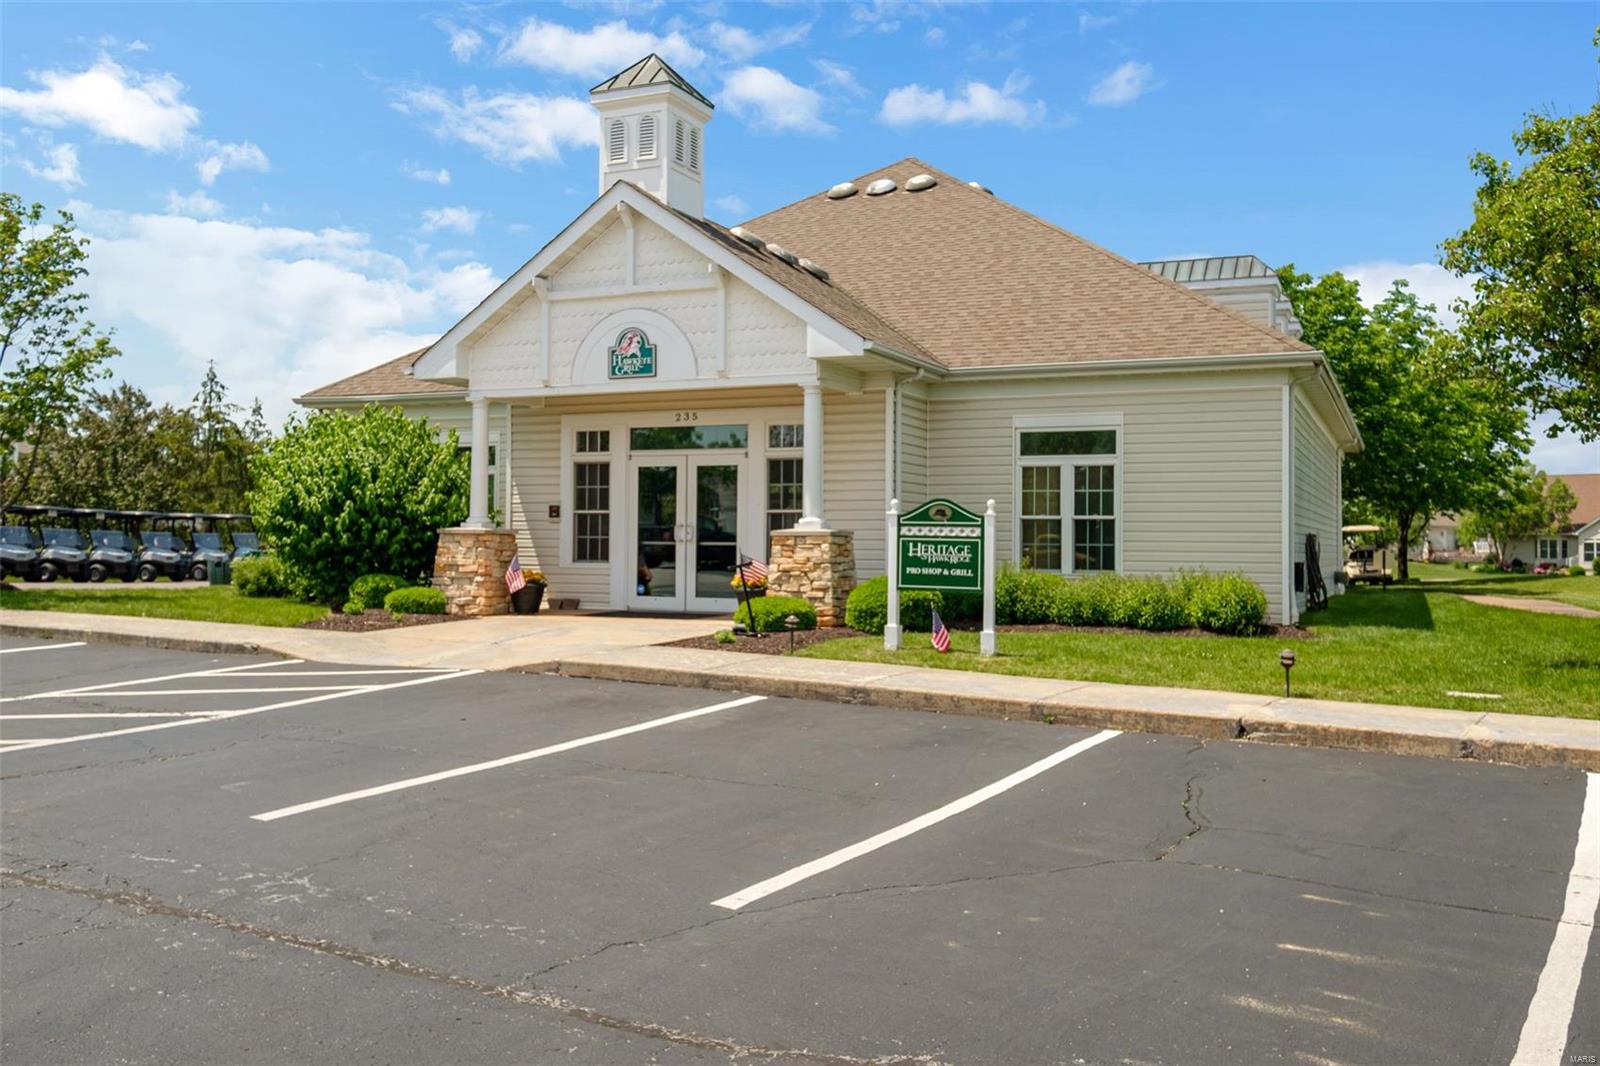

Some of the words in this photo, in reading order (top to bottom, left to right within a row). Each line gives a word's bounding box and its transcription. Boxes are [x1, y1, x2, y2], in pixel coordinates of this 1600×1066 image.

[675, 411, 698, 422] 235
[908, 542, 972, 557] HERITAGE
[906, 567, 921, 575] PRO
[922, 567, 942, 575] SHOP
[942, 568, 949, 576] &
[950, 568, 973, 577] GRILL
